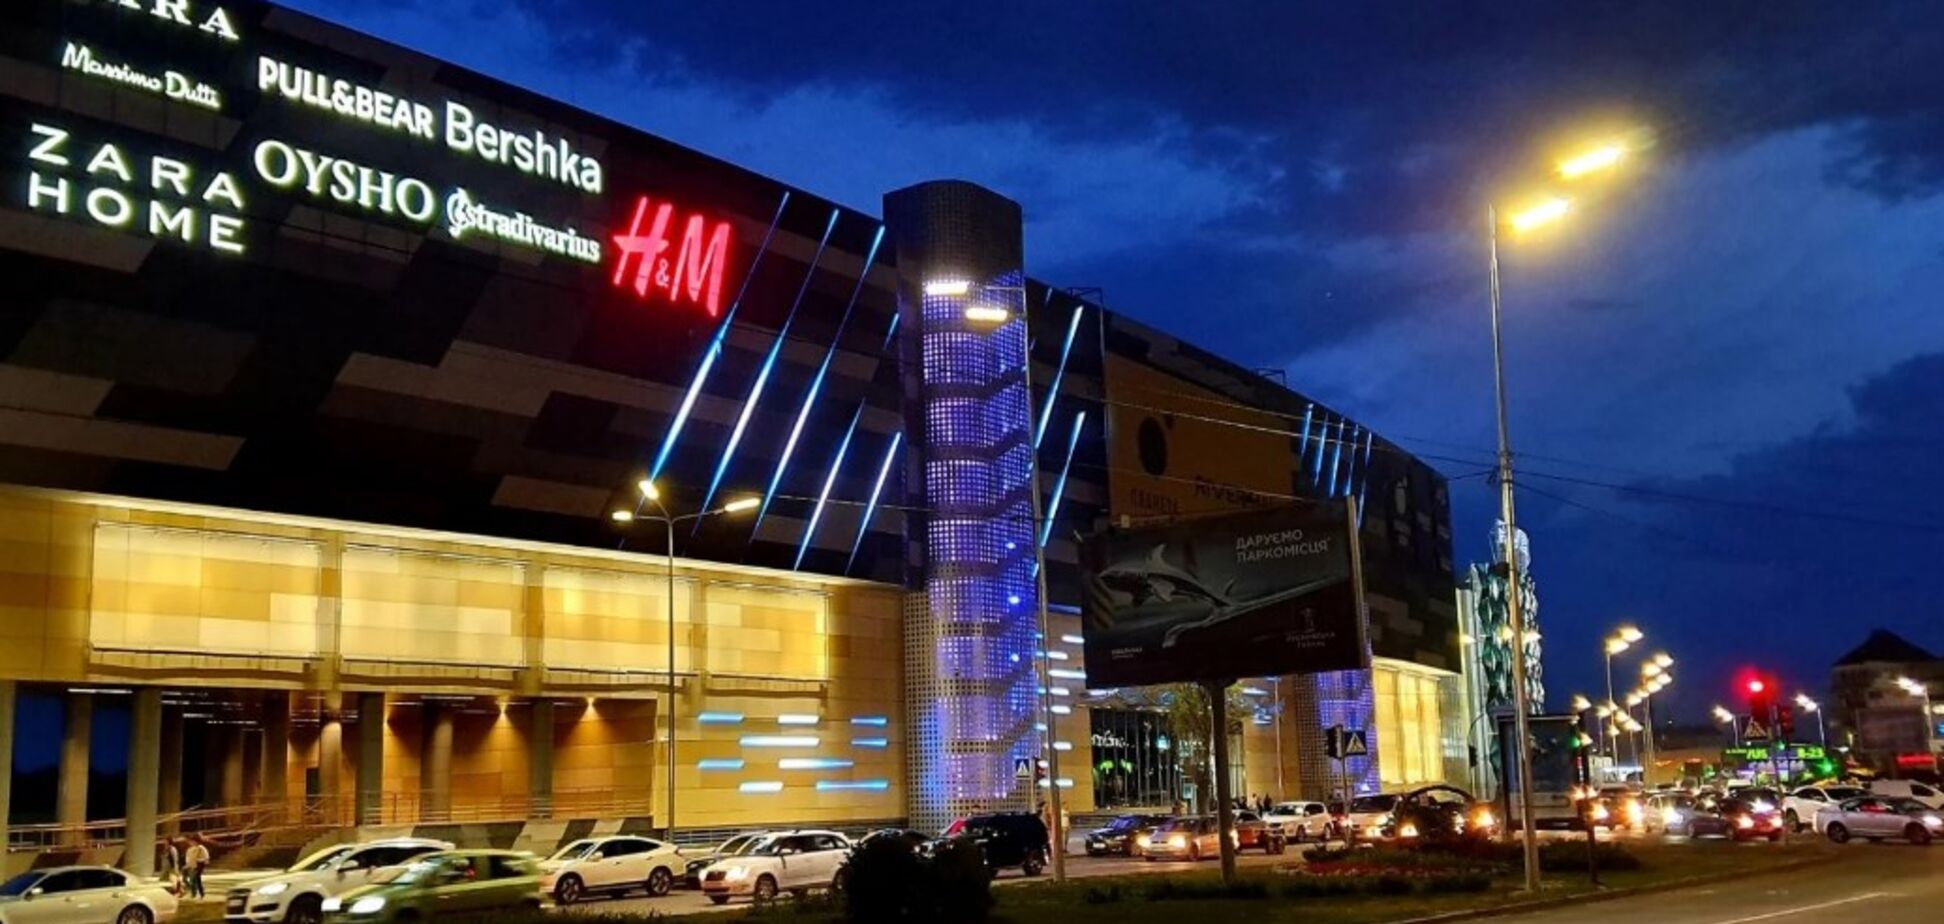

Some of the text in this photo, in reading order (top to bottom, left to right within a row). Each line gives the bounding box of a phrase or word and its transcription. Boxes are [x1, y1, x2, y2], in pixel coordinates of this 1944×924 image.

[62, 42, 221, 109] Massimo Dutti
[258, 55, 433, 139] PULL&BEAR
[28, 123, 243, 208] ZARA
[254, 139, 435, 221] OYSHO
[445, 100, 602, 194] Bershka
[28, 171, 244, 251] HOME
[612, 196, 730, 317] H&M
[1236, 529, 1303, 550] ДАРУЄМО
